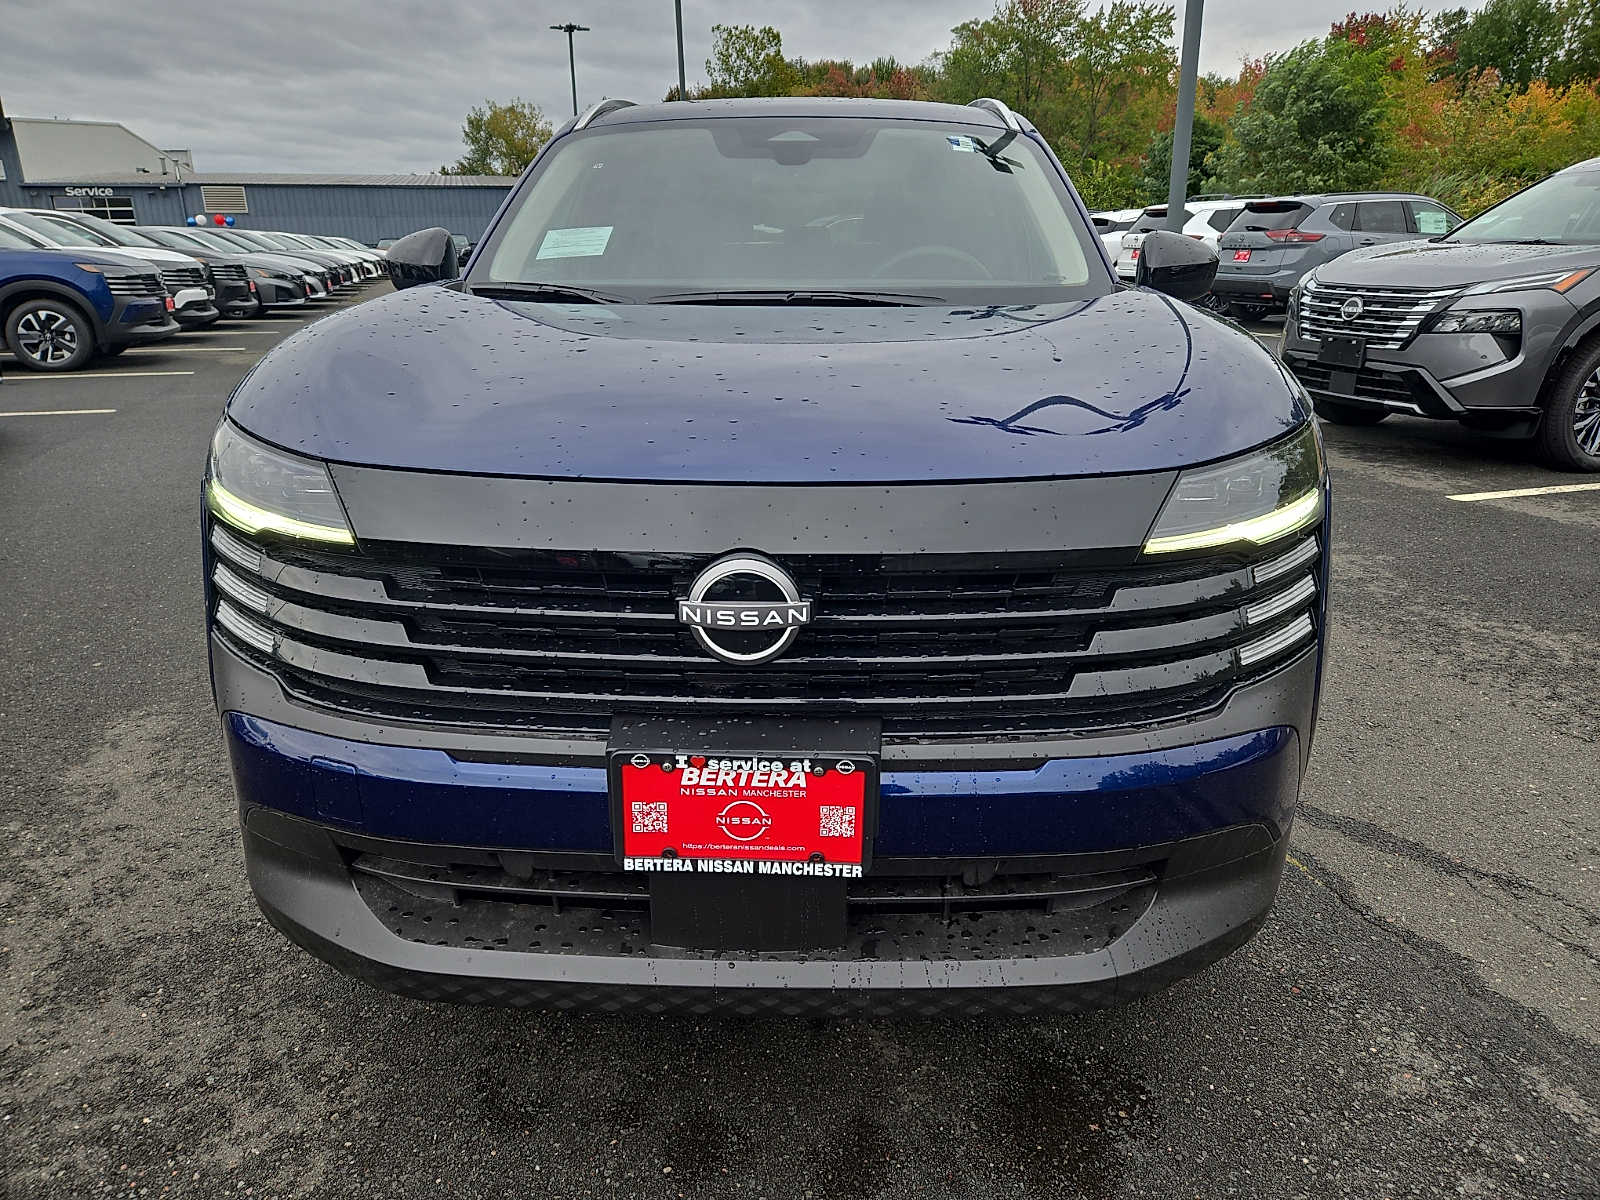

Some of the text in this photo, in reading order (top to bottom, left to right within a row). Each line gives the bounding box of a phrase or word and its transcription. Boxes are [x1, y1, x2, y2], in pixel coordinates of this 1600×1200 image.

[65, 187, 113, 196] Service
[682, 606, 807, 626] NISSAN
[675, 755, 811, 773] I service at
[680, 767, 807, 788] BERTERA
[680, 788, 807, 798] NISSAN MANCHESTER
[716, 817, 772, 825] NISSAN
[682, 843, 806, 851] https://berteranissandeals.com
[623, 858, 863, 878] BERTERA NISSAN MANCHESTER
